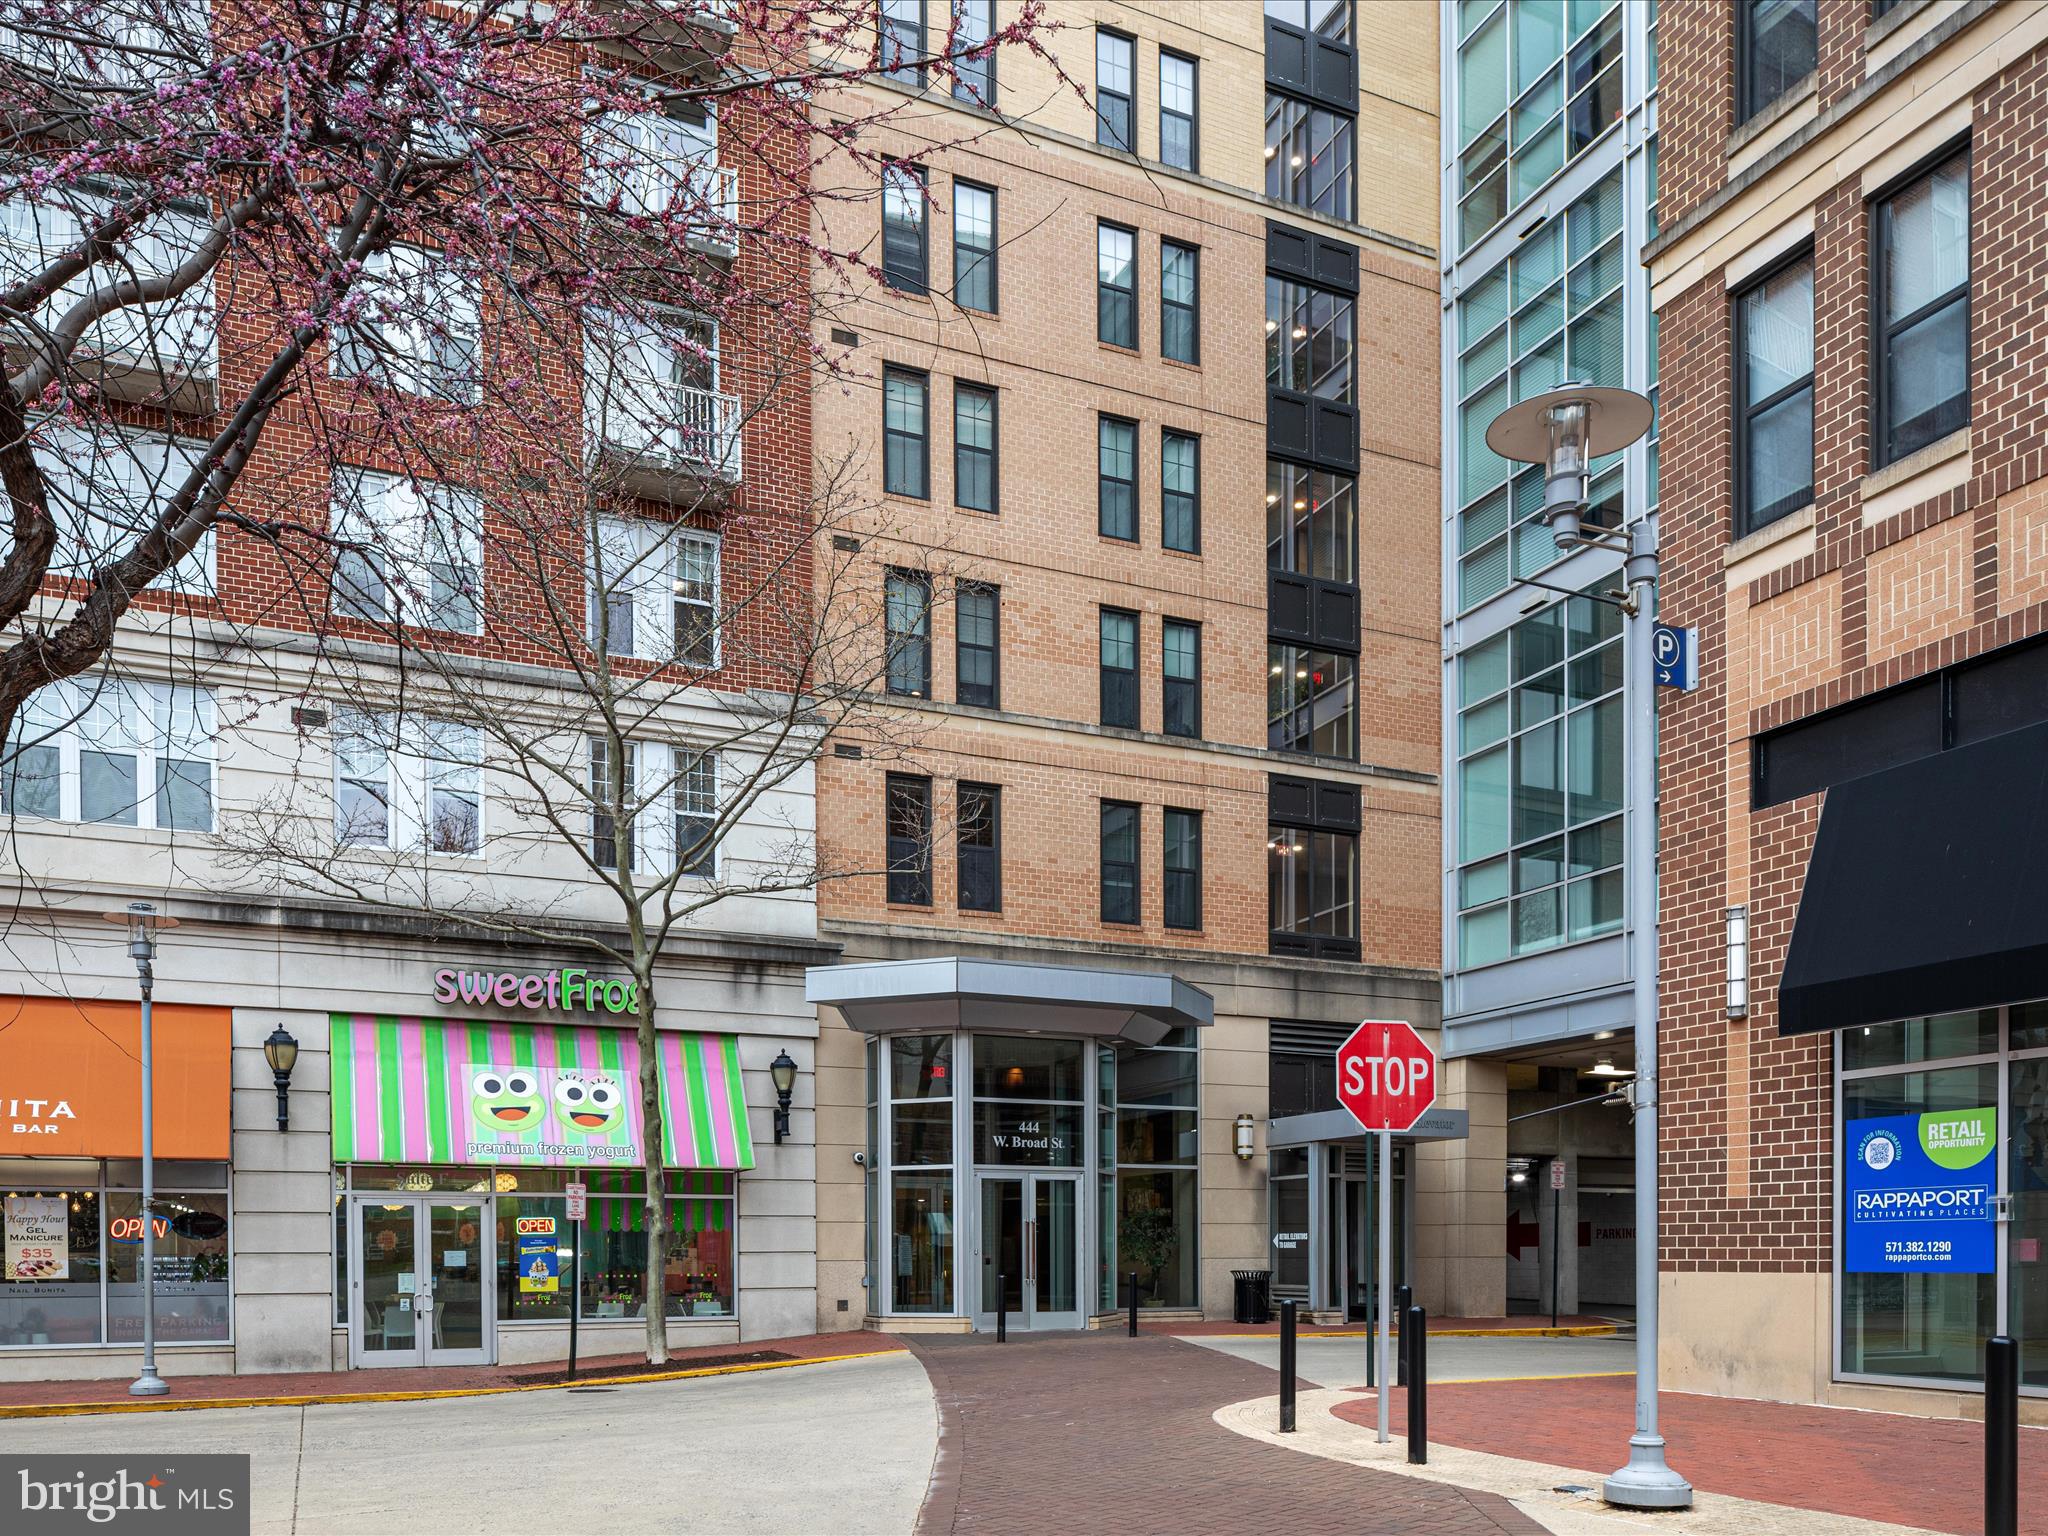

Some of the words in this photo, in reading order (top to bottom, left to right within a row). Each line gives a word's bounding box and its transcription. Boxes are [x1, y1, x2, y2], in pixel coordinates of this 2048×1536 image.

[1658, 634, 1674, 660] P
[1344, 1055, 1429, 1097] STOP
[0, 1098, 77, 1119] ITA
[12, 1123, 59, 1134] BAR
[1018, 1121, 1040, 1134] 444
[1928, 1119, 1986, 1140] RETAIL
[992, 1135, 1009, 1148] W.
[1011, 1136, 1048, 1148] Broad
[1051, 1137, 1065, 1149] St.
[1857, 1143, 1867, 1161] SCAN
[1863, 1131, 1875, 1143] FOR
[1874, 1129, 1903, 1161] INFORMATION
[1928, 1137, 1985, 1149] OPPORTUNITY
[467, 1141, 534, 1156] premium
[537, 1142, 584, 1156] frozen
[587, 1145, 637, 1159] yogurt
[1857, 1189, 1984, 1210] RAPPAPORT
[1856, 1209, 1934, 1218] CULTIVATING
[1939, 1208, 1985, 1216] PLACES
[7, 1214, 39, 1226] Happy
[40, 1214, 66, 1224] Hour
[519, 1219, 555, 1232] OPEN
[21, 1247, 53, 1259] $35
[1885, 1241, 1952, 1252] 571.382.1290
[1885, 1253, 1952, 1263] rappaportco.com
[115, 1318, 143, 1328] FRE
[114, 1328, 144, 1337] INSID
